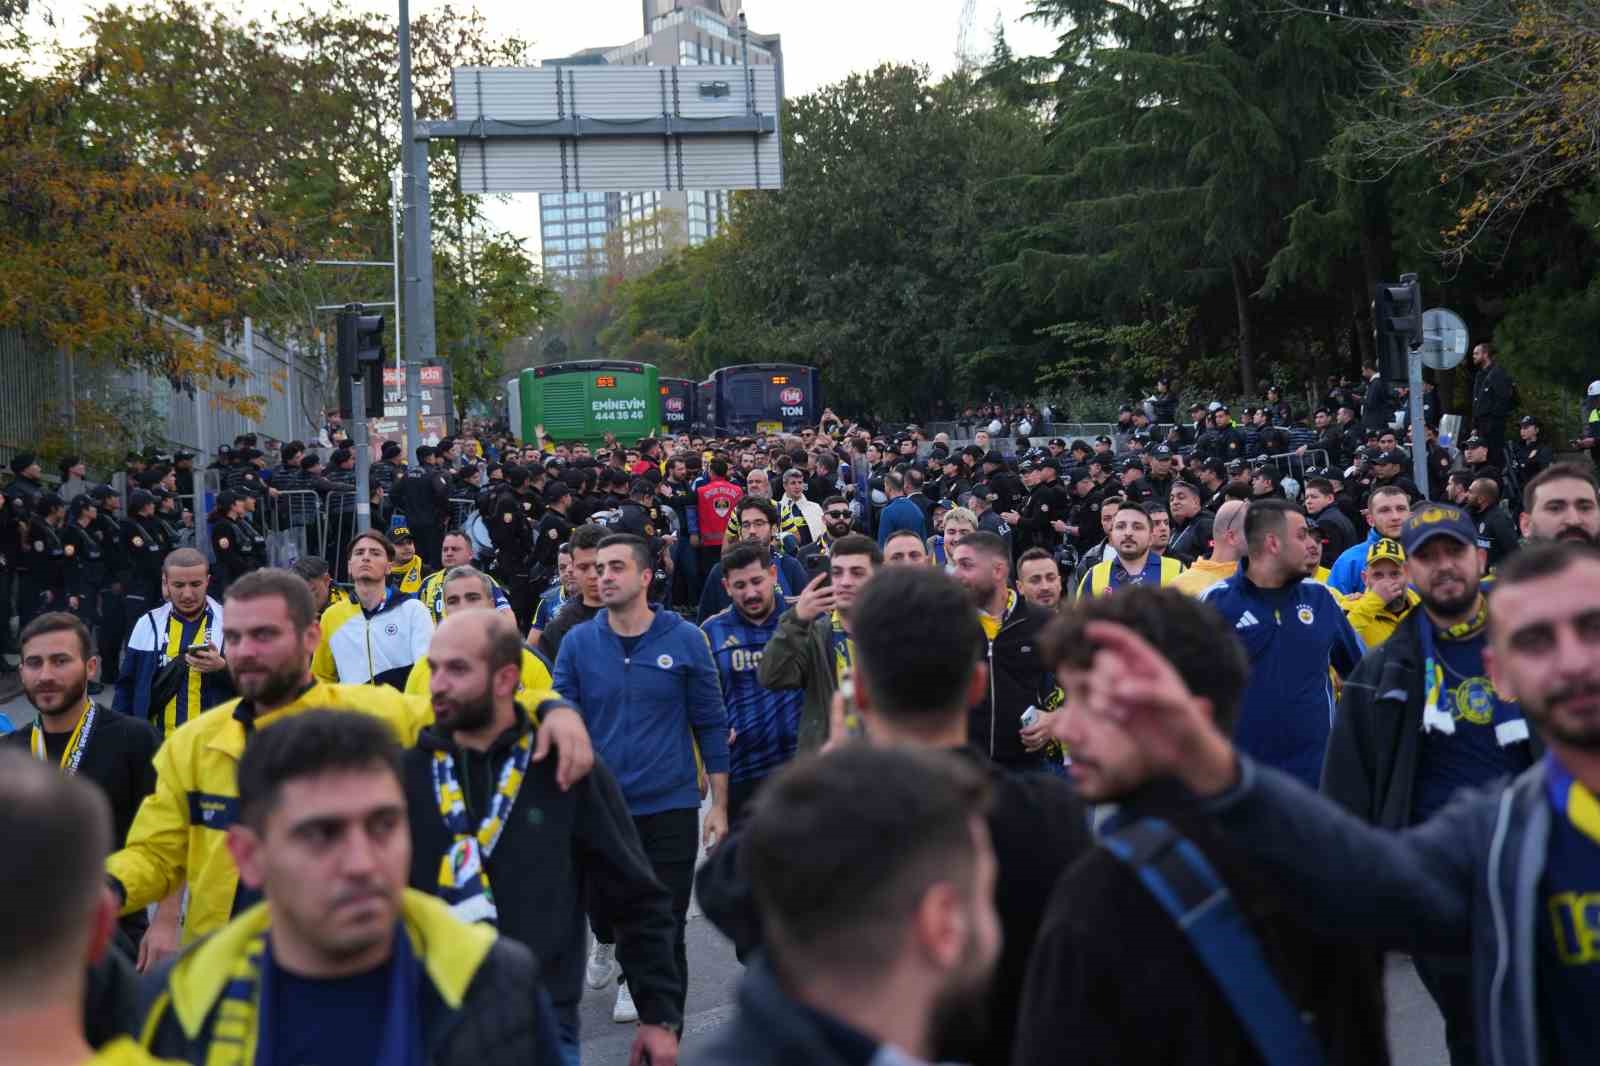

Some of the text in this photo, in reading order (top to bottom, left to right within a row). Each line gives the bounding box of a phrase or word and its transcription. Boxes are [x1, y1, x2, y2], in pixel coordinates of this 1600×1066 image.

[592, 397, 645, 411] EMİNEVİM
[594, 411, 615, 420] 444
[781, 406, 803, 416] TON
[666, 413, 684, 421] TON
